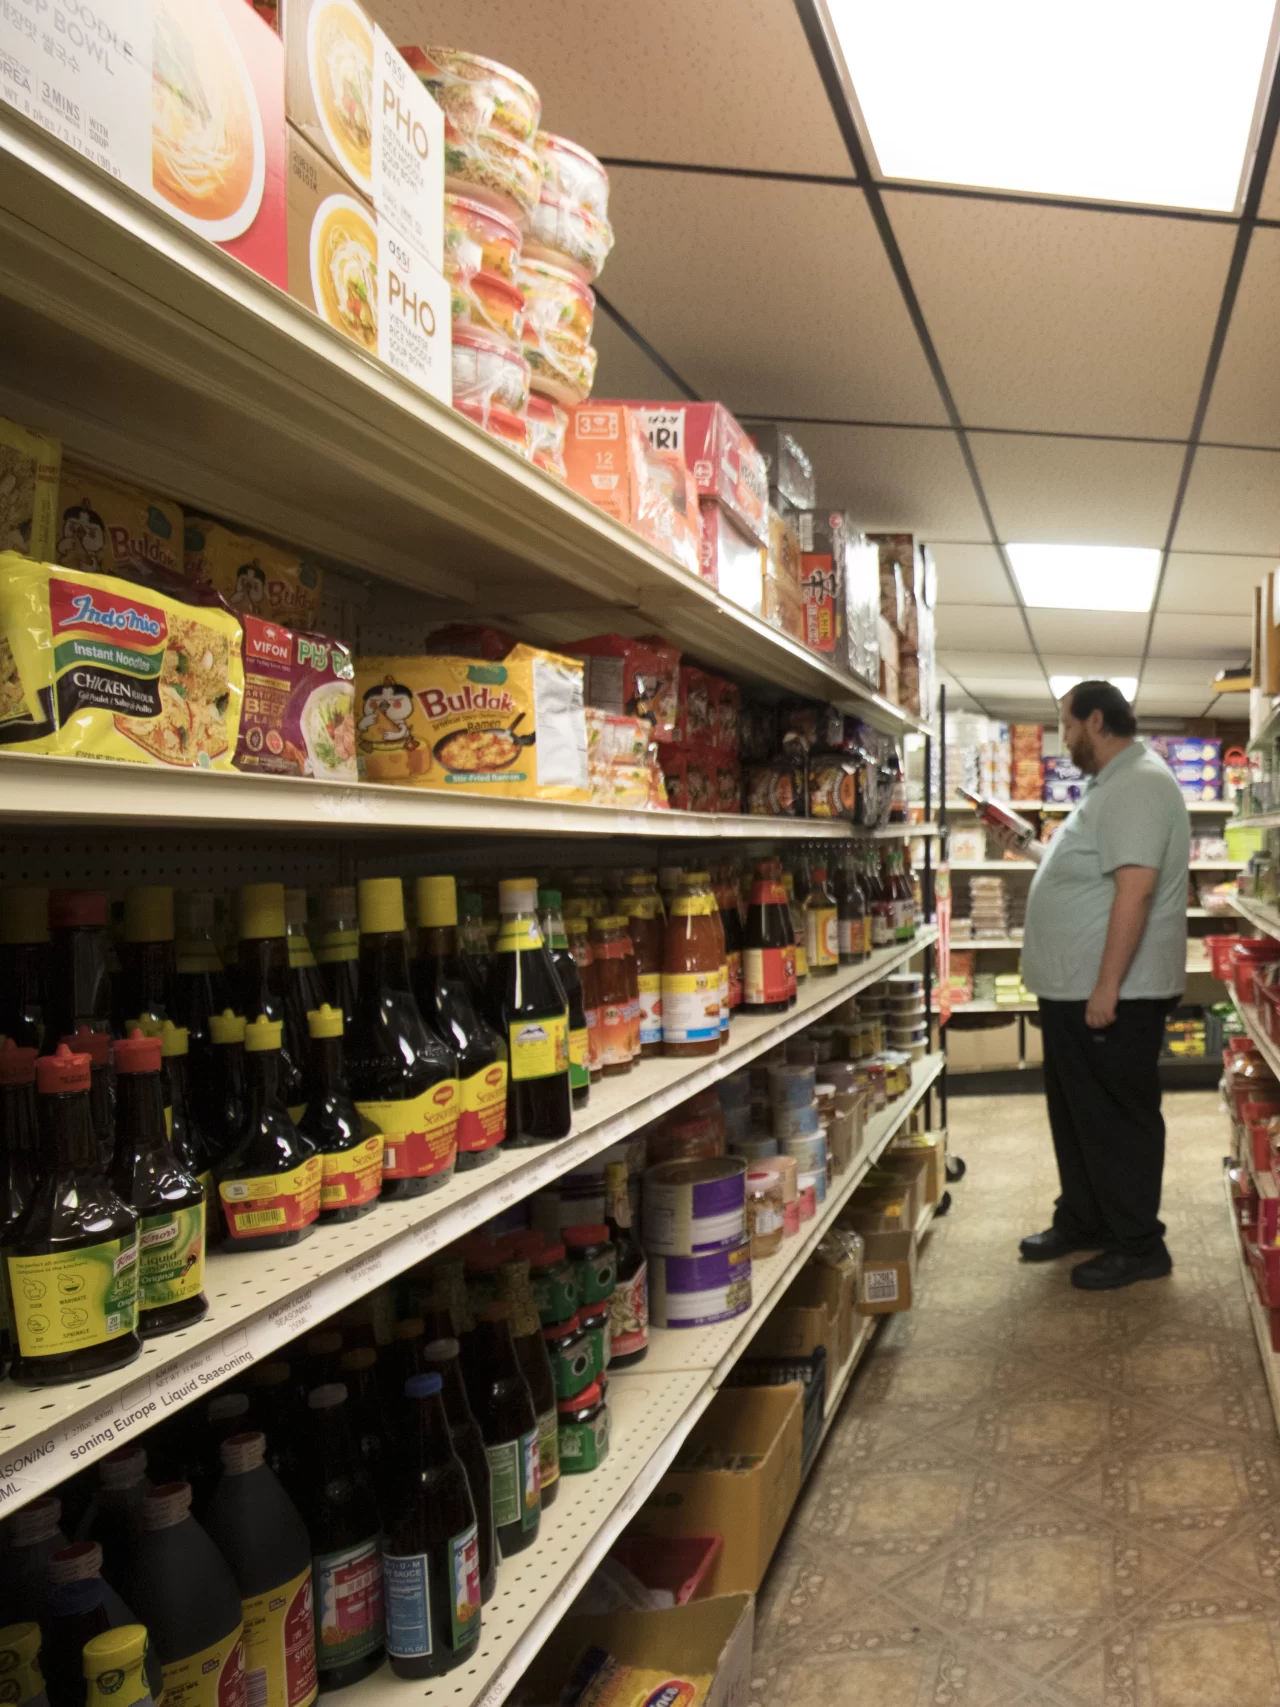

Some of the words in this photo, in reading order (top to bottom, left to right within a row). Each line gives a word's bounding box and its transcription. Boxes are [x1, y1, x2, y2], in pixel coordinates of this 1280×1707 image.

[54, 8, 115, 76] BOWL
[42, 82, 50, 98] 3
[53, 88, 80, 121] MINS
[24, 99, 31, 113] 8
[33, 107, 56, 132] pkgs
[63, 128, 82, 150] 3.17
[89, 115, 109, 138] WITH
[383, 79, 429, 160] PHO
[89, 128, 110, 149] SOUP
[388, 239, 410, 269] assi
[388, 269, 436, 337] PHO
[581, 416, 591, 434] 3
[73, 642, 114, 663] Instant
[115, 651, 151, 673] Noodles
[253, 640, 289, 659] VIFON
[73, 671, 131, 698] CHICKEN
[245, 698, 285, 716] BEEF
[416, 685, 516, 721] Buldak
[467, 718, 502, 734] Ramen
[140, 1226, 177, 1246] Knorr
[23, 1260, 43, 1270] perfect
[140, 1258, 183, 1274] easoning
[141, 1270, 175, 1285] Original
[275, 1301, 313, 1330] SEASONING
[69, 1427, 115, 1460] soning
[114, 1400, 157, 1432] Europe
[160, 1380, 199, 1407] Liquid
[198, 1350, 254, 1386] Seasoning
[0, 1440, 56, 1480] ASONING
